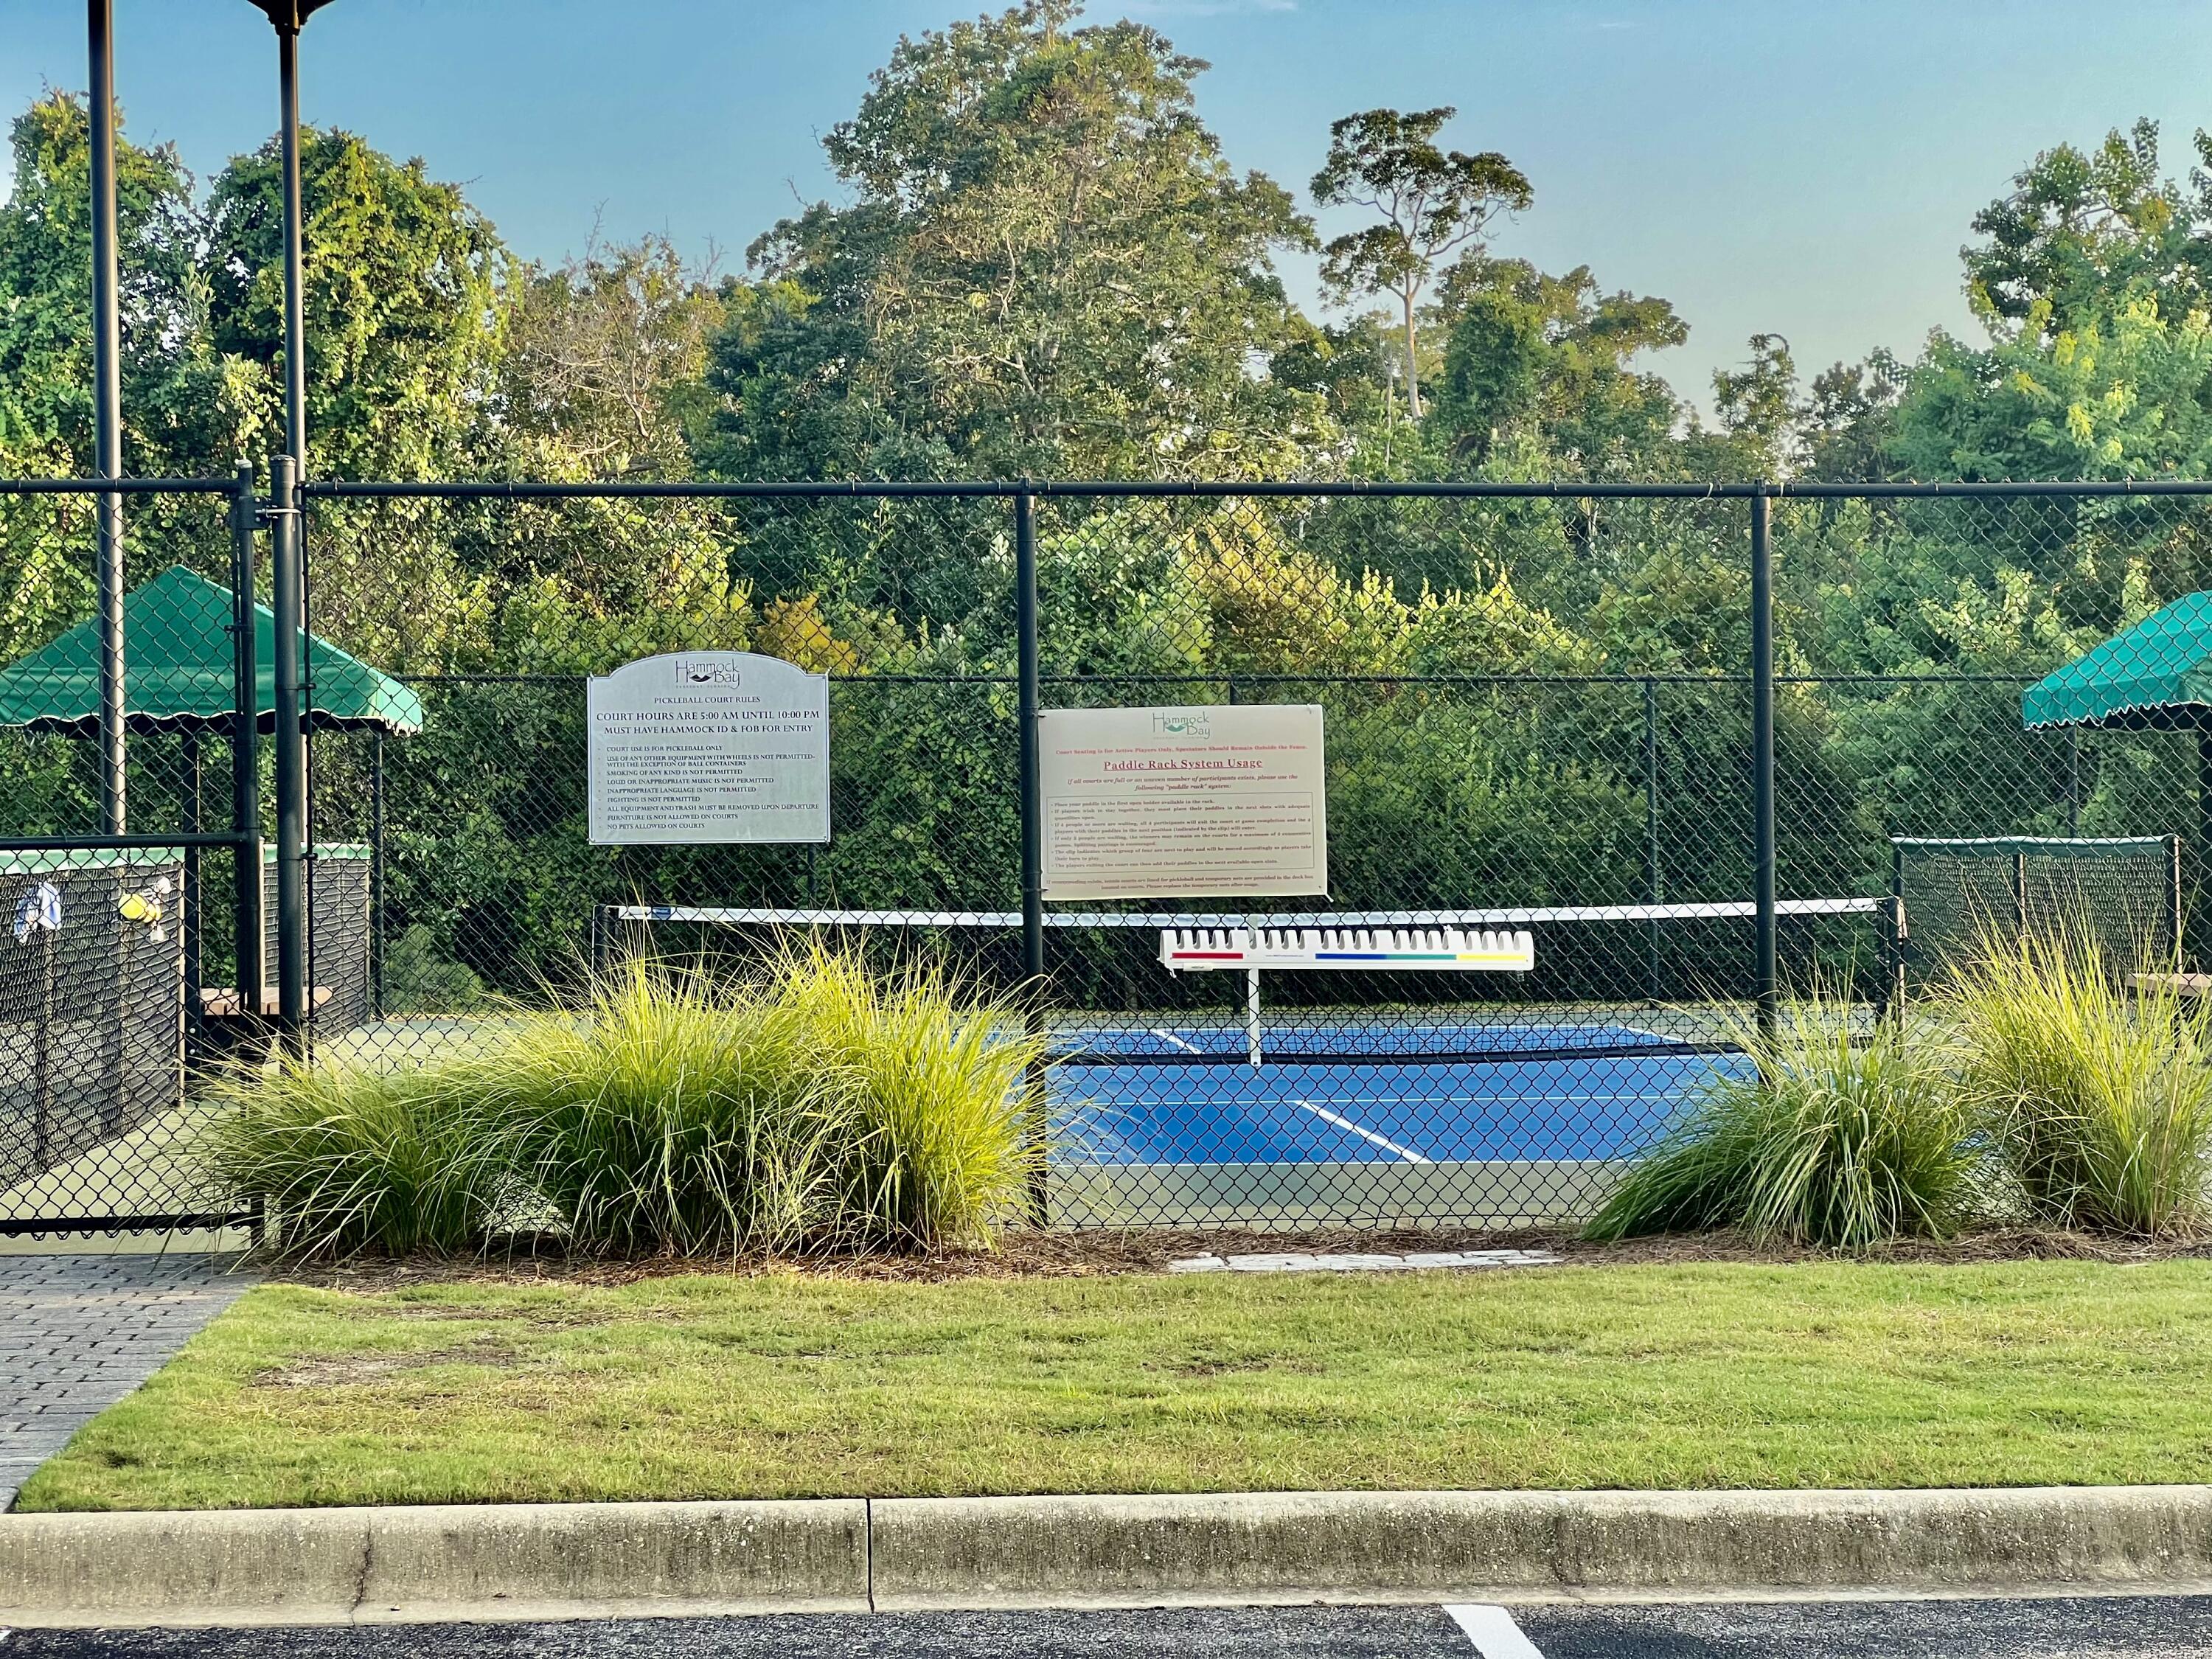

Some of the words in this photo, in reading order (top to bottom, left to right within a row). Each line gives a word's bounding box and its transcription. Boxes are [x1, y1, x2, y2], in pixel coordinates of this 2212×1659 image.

[675, 658, 740, 683] Hammock
[714, 672, 740, 689] Bay
[636, 712, 674, 720] HOURS
[700, 712, 719, 720] 5:00
[742, 711, 774, 719] UNTIL
[1152, 712, 1209, 732] Hammock
[1186, 725, 1211, 740] Bay
[1103, 760, 1144, 771] Paddle
[1148, 759, 1177, 769] Rack
[1180, 759, 1223, 770] System
[1228, 758, 1263, 768] Usage
